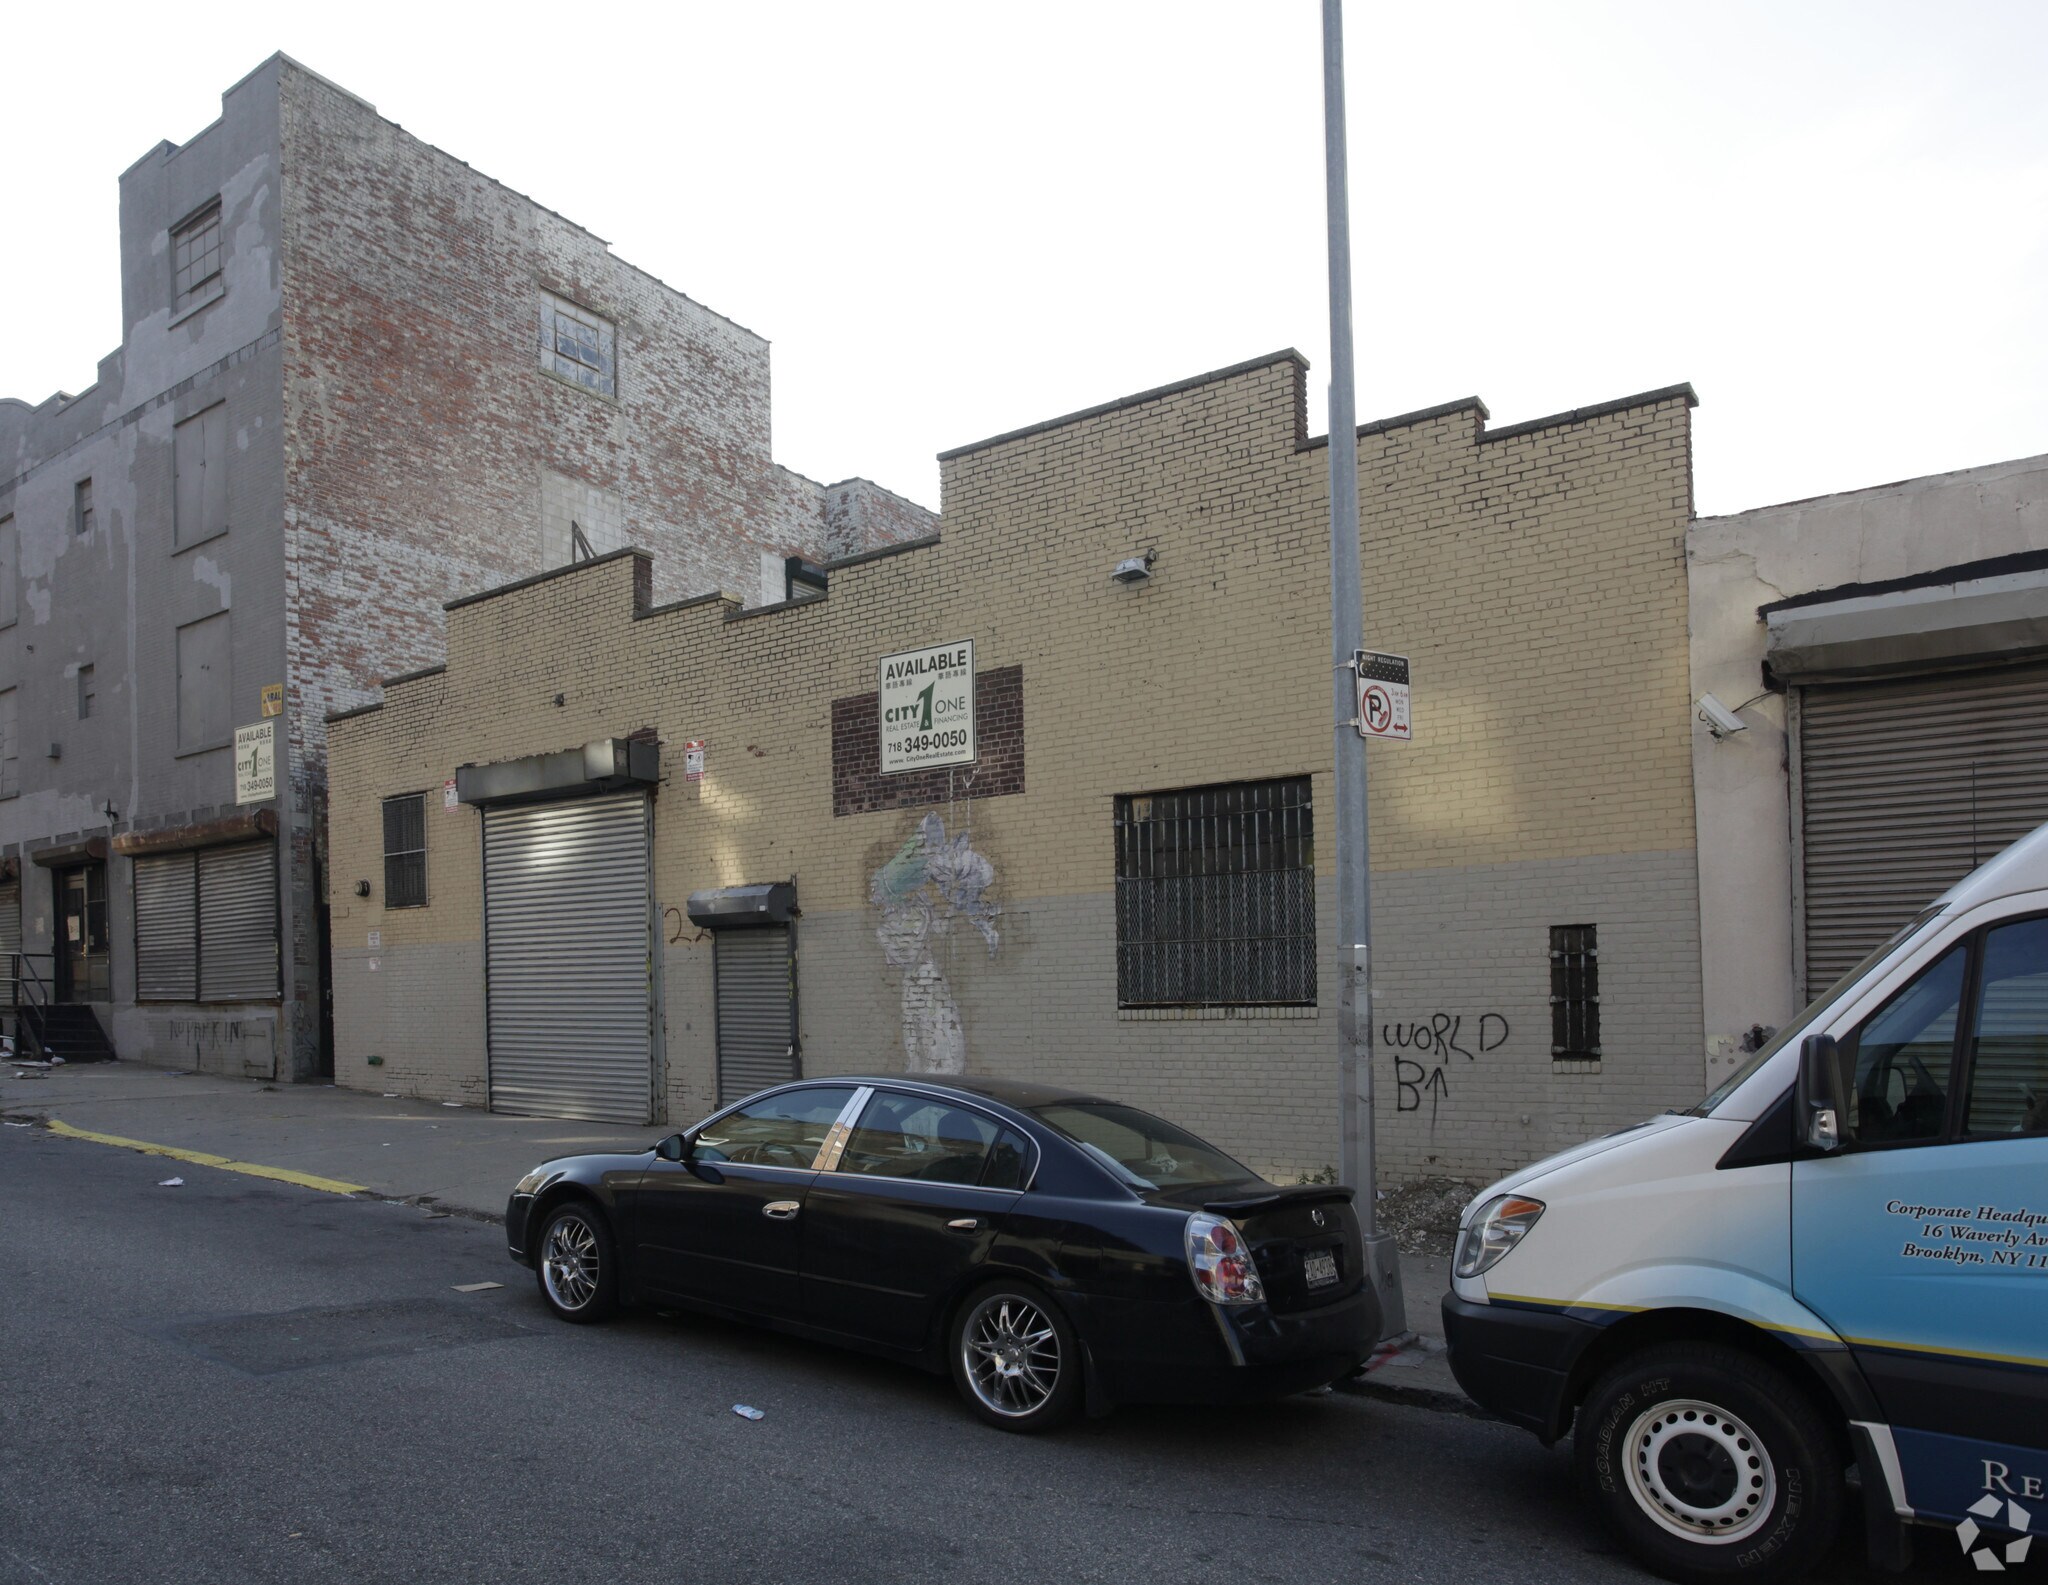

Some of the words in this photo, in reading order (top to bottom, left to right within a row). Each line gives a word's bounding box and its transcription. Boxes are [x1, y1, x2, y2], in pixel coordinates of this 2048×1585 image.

[885, 649, 967, 680] AVAILABLE
[1361, 653, 1376, 661] NIGHT
[1377, 656, 1405, 667] REGULATION
[885, 703, 920, 723] CITY
[935, 696, 966, 714] ONE
[885, 723, 900, 733] REAL
[900, 721, 920, 731] ESTATE
[933, 712, 969, 725] FINANCING
[238, 726, 272, 743] AVAILABLE
[887, 741, 902, 754] 718
[904, 729, 967, 754] 349-0050
[237, 759, 252, 772] CITY
[258, 755, 271, 767] ONE
[906, 749, 966, 763] CityOneRealEstate.com
[1383, 1012, 1509, 1065] WORLD
[1886, 1200, 1972, 1220] Corporate
[1922, 1224, 1945, 1238] 16
[1949, 1225, 2021, 1248] Waverly
[1902, 1243, 1986, 1265] Brooklyn,
[1990, 1250, 2024, 1266] NY
[1596, 1392, 1636, 1494] ROADIAN
[1640, 1377, 1671, 1397] HT
[1736, 1467, 1802, 1569] NEXEN
